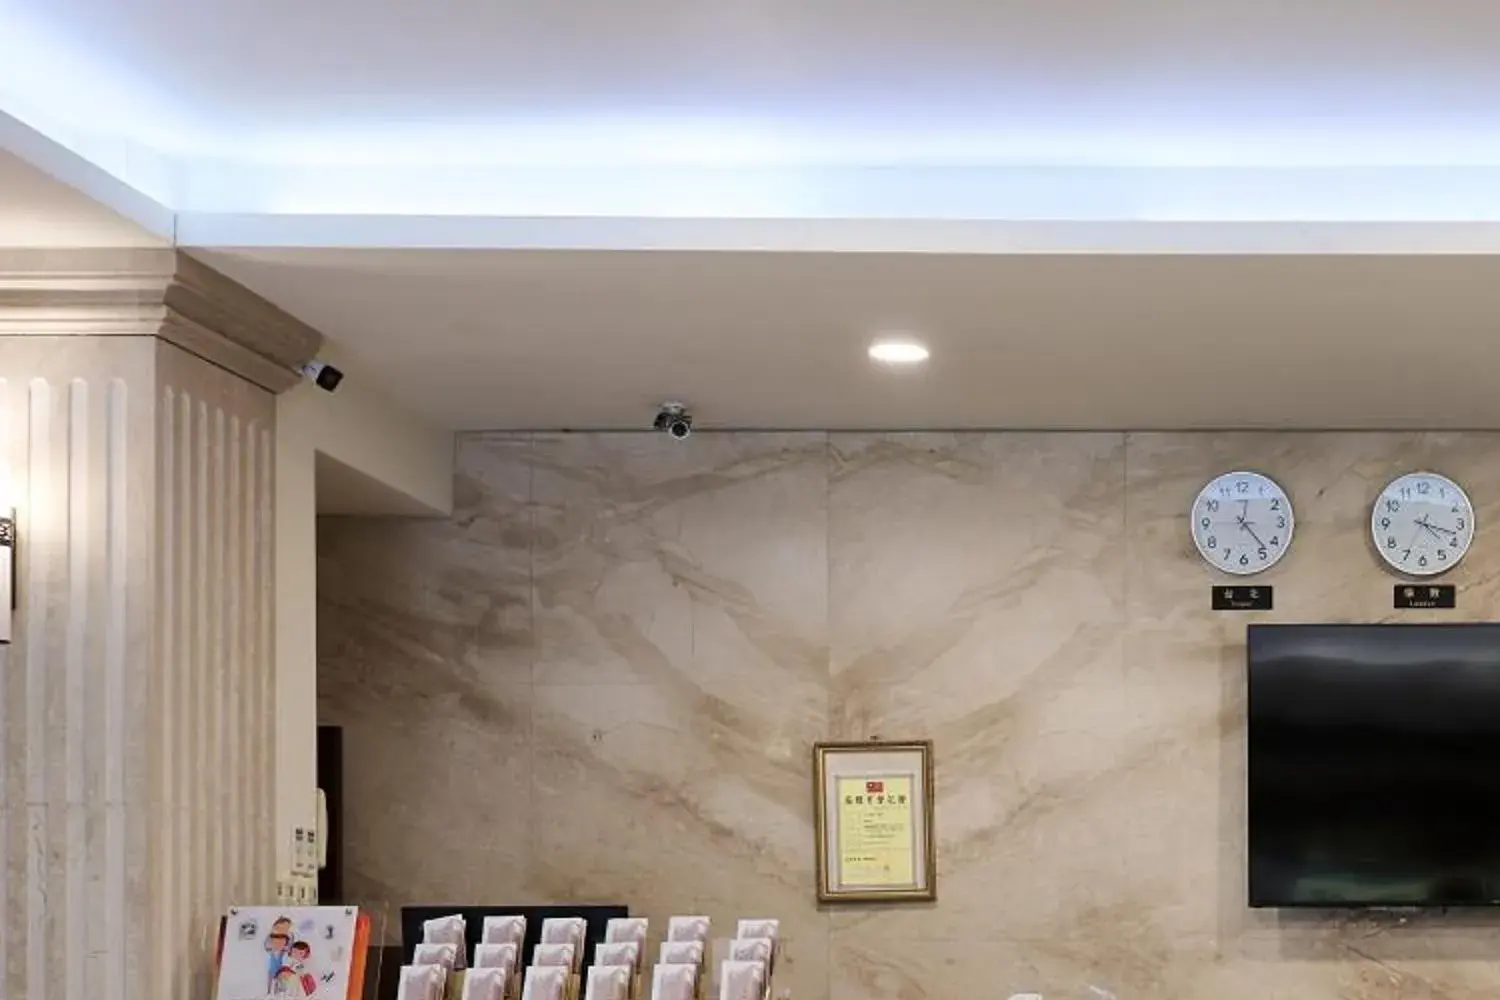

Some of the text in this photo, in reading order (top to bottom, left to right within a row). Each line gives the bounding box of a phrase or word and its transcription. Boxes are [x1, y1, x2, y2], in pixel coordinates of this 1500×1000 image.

[1236, 482, 1249, 493] 12
[1417, 482, 1430, 494] 12
[1401, 488, 1410, 499] 11
[1206, 499, 1218, 512] 10
[1270, 499, 1280, 511] 2
[1386, 500, 1400, 512] 10
[1202, 518, 1210, 529] 9
[1277, 517, 1285, 528] 3
[1381, 517, 1390, 529] 9
[1456, 518, 1464, 530] 3
[1207, 536, 1216, 548] 8
[1270, 536, 1279, 546] 4
[1387, 536, 1396, 548] 8
[1450, 537, 1457, 547] 4
[1224, 548, 1231, 560] 7
[1258, 547, 1267, 560] 5
[1402, 549, 1411, 560] 7
[1437, 549, 1446, 560] 5
[1240, 554, 1248, 565] 6
[1418, 556, 1427, 566] 6
